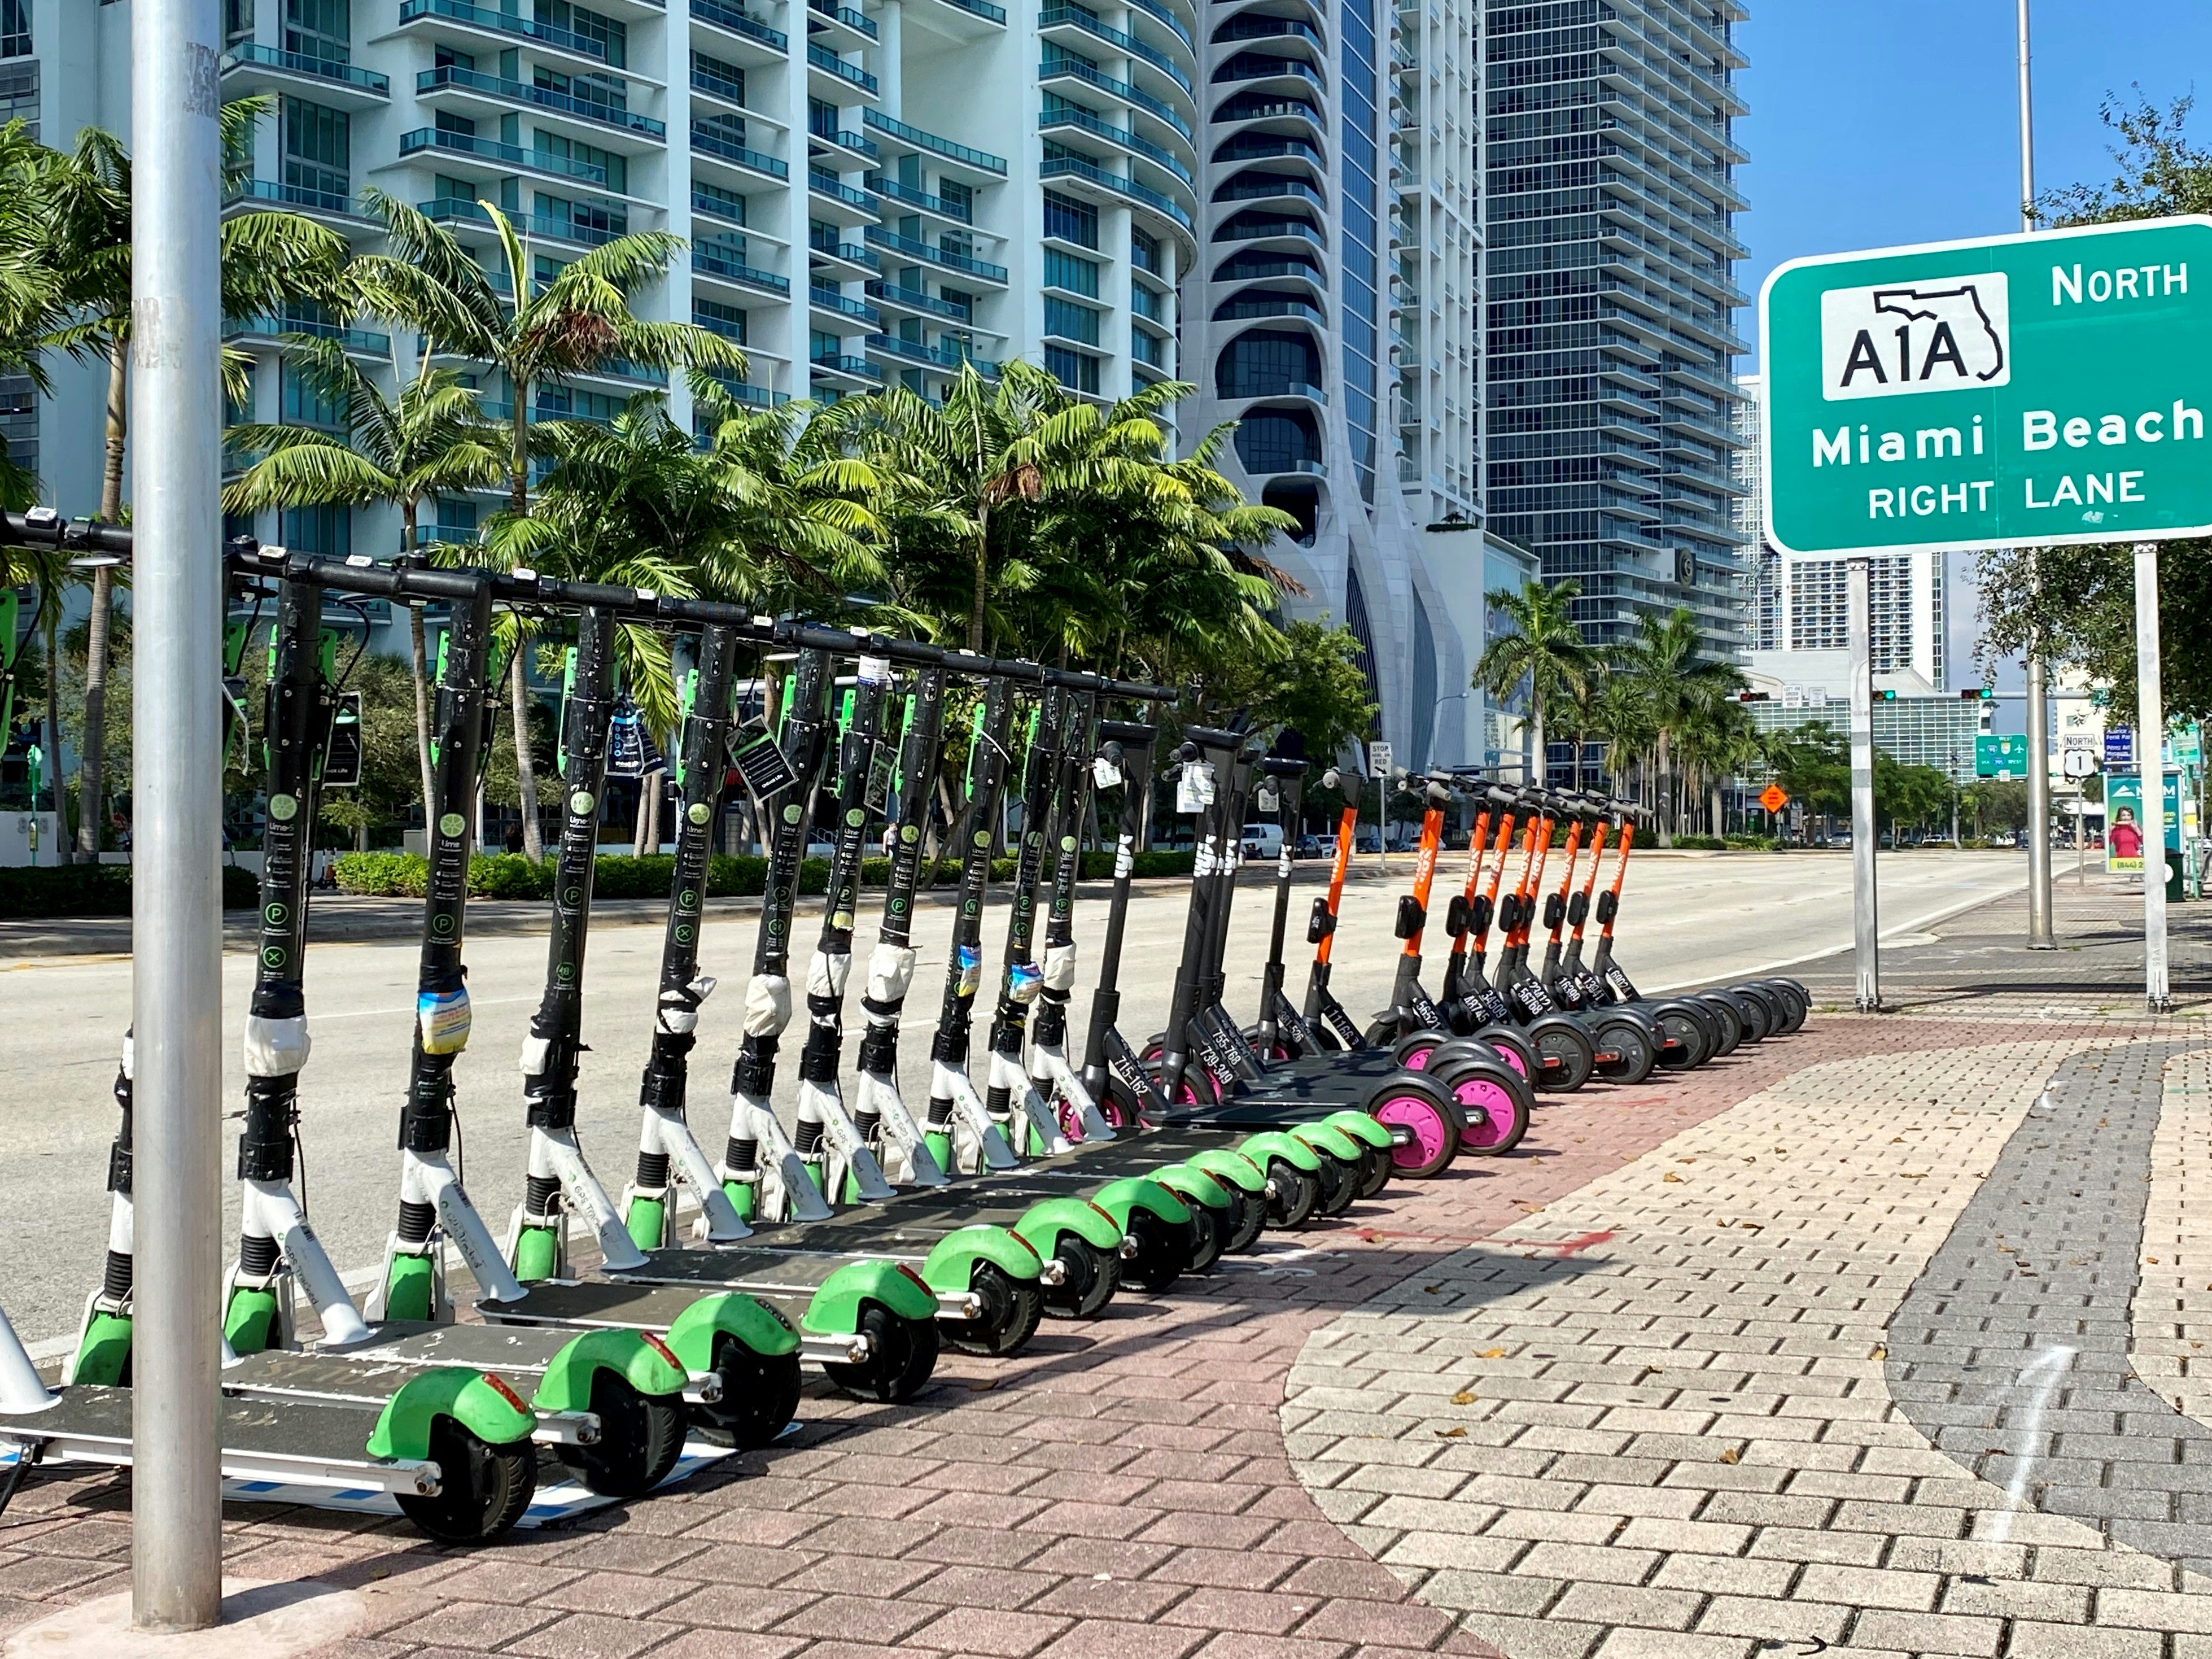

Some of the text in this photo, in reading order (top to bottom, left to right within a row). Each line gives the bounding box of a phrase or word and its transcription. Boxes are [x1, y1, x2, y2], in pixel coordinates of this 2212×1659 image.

[2052, 263, 2188, 305] NORTH
[1840, 321, 1969, 387] A1A
[1812, 399, 2204, 467] Miami Beach
[1869, 470, 2146, 518] RIGHT LANE
[2066, 737, 2093, 745] NORTH
[2078, 756, 2082, 770] 1
[762, 778, 776, 788] Unlock
[1529, 981, 1551, 1007] 23412
[1558, 977, 1581, 1002] 16399
[1610, 970, 1632, 994] 69024
[1417, 1000, 1442, 1030] 56521
[1463, 995, 1490, 1023] 48745
[1481, 989, 1507, 1019] 34509
[1518, 988, 1544, 1015] 56768
[1327, 1010, 1354, 1041] 11166
[1212, 1028, 1241, 1066] 755-768
[1114, 1055, 1148, 1097] 715-162
[1200, 1045, 1233, 1085] 739-349
[575, 1186, 588, 1206] GPS
[285, 1245, 319, 1306] GPS Tracked
